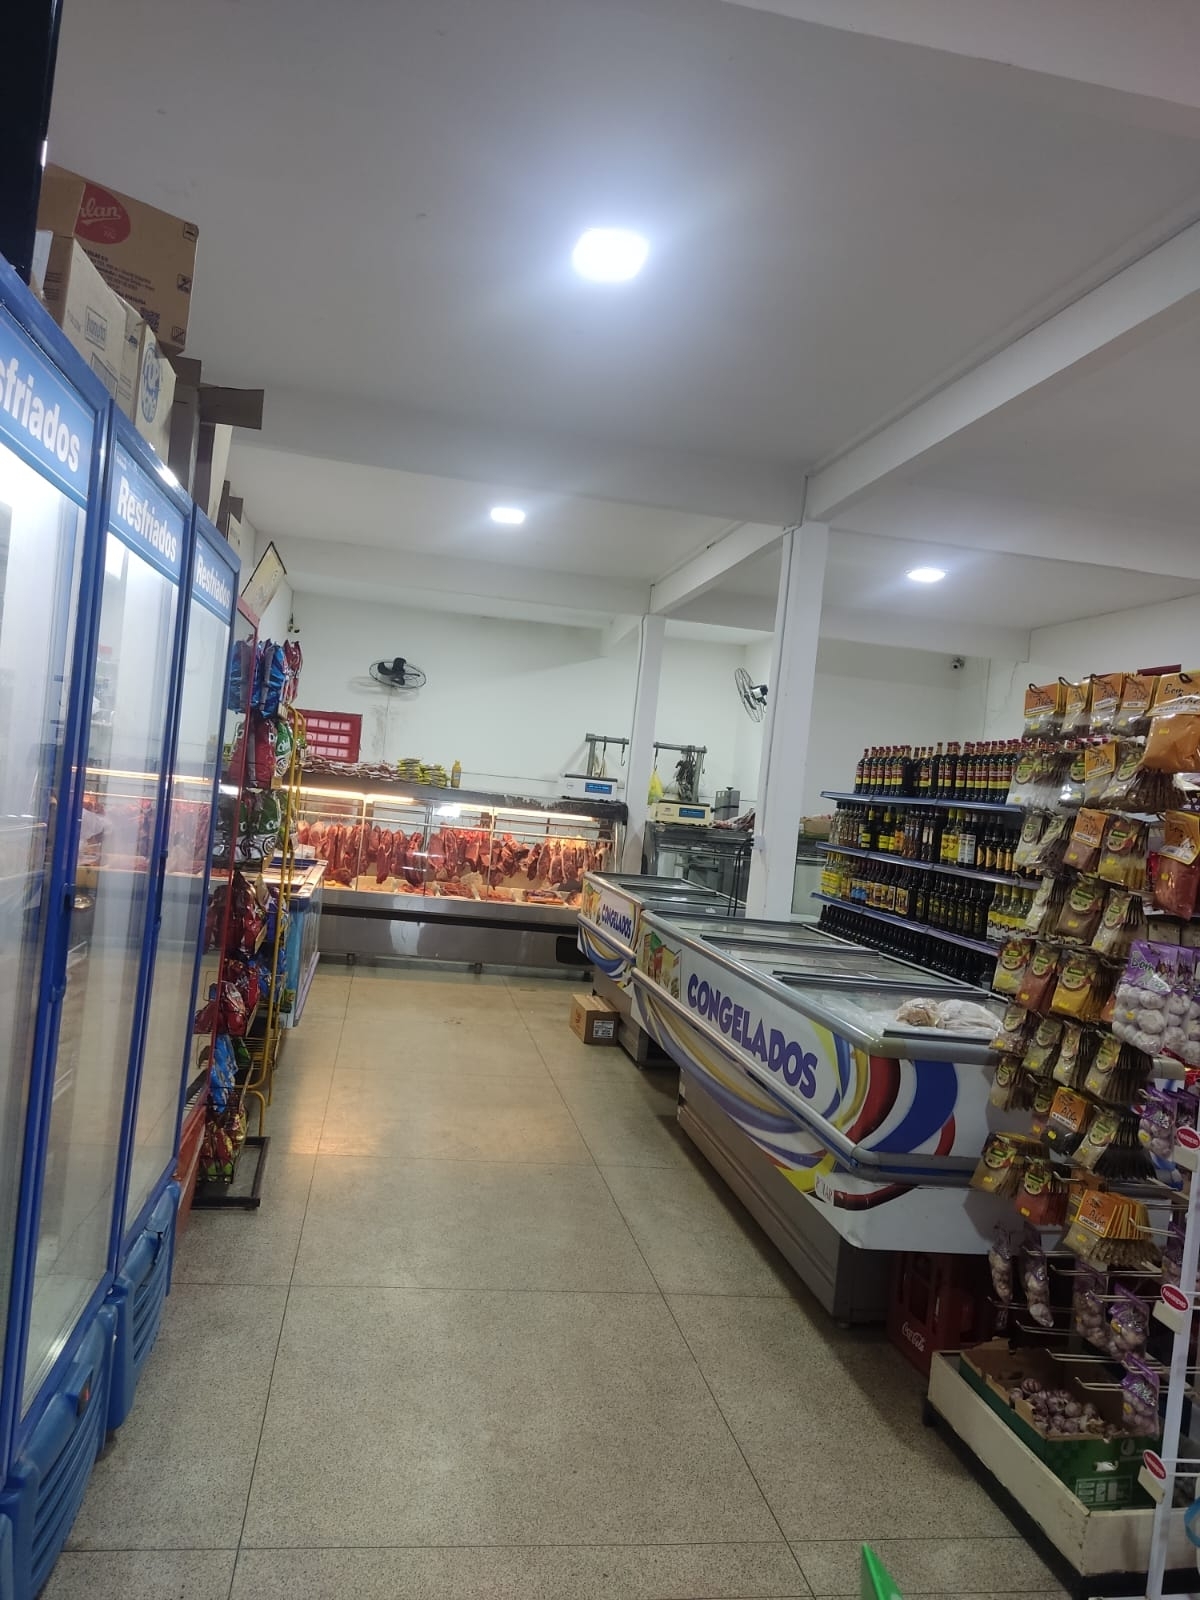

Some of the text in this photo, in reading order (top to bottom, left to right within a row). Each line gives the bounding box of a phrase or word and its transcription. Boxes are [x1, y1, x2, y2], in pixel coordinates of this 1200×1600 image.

[117, 475, 177, 563] Resfriados
[195, 556, 231, 610] Resfriados
[601, 903, 632, 940] CONGELADOS
[687, 973, 818, 1099] CONGELADOS
